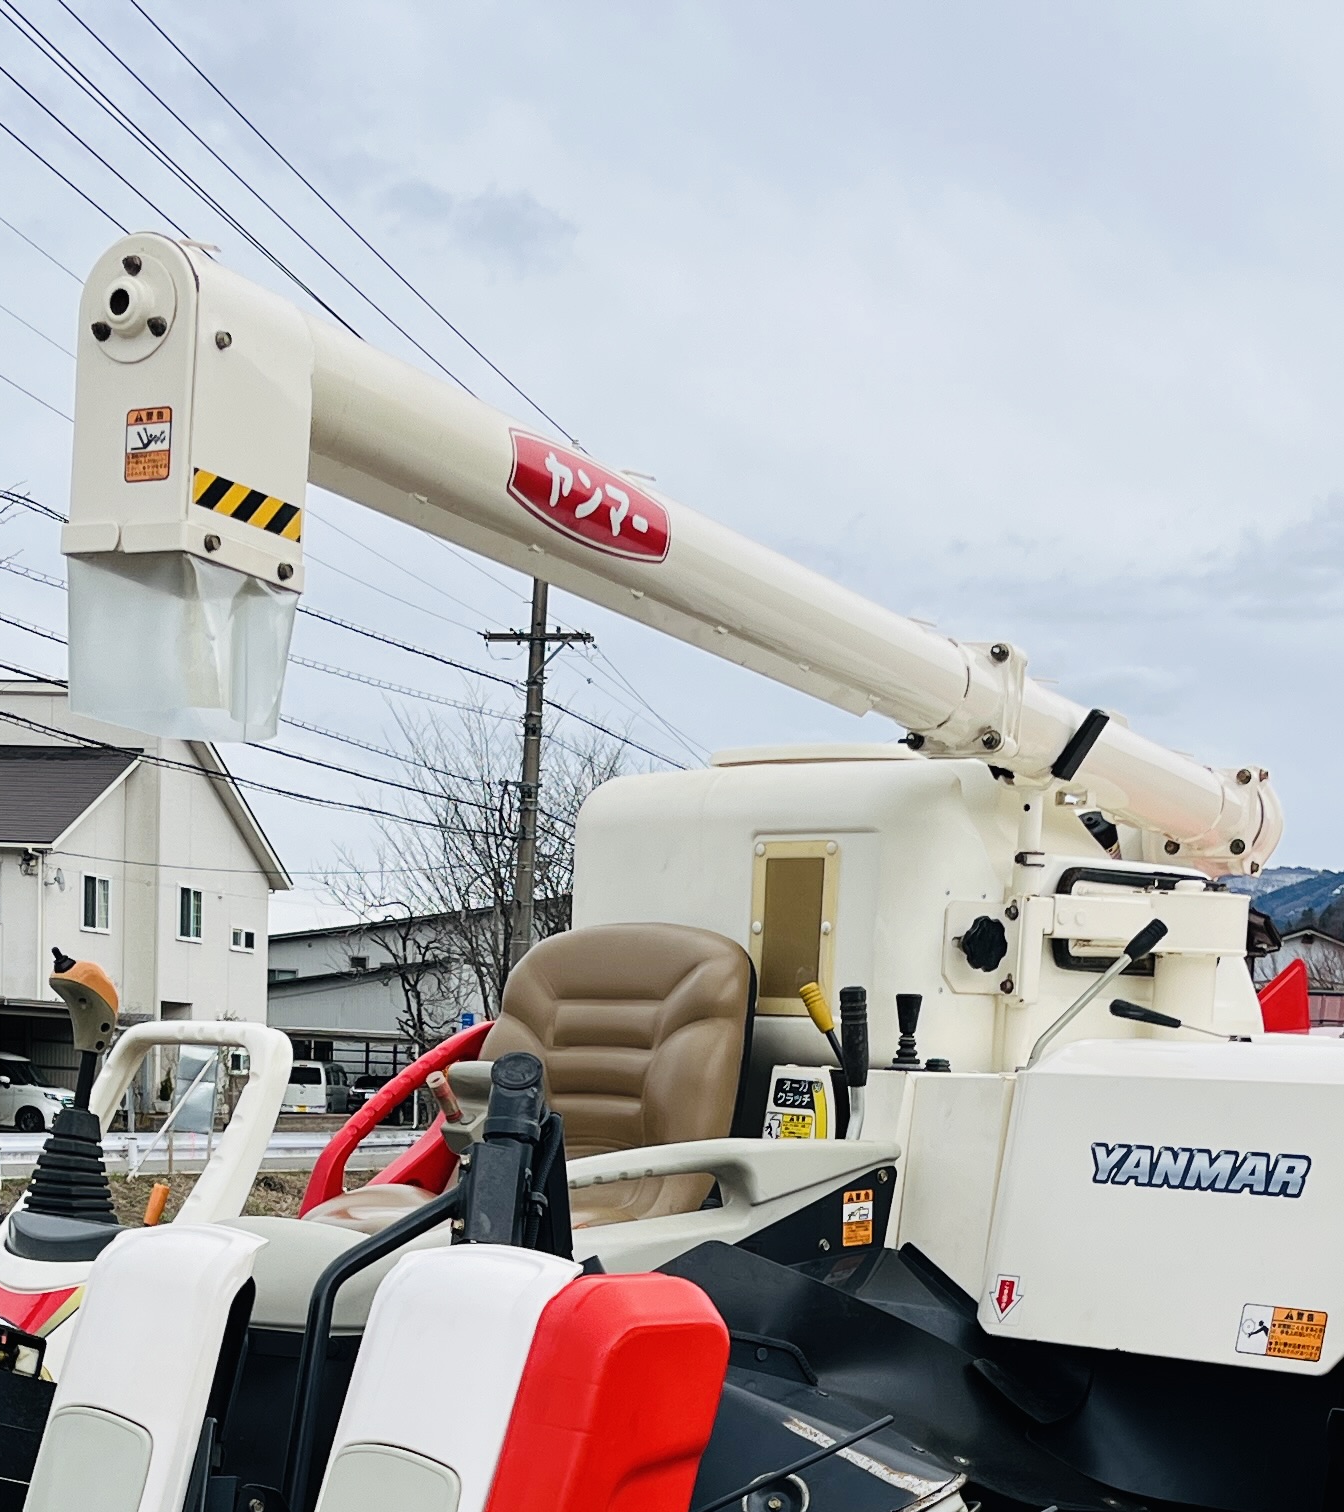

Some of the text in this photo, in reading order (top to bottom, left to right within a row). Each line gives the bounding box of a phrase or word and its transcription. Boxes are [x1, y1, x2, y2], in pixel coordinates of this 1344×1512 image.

[545, 452, 649, 537] ヤンマー
[777, 1092, 811, 1106] クラッチ
[782, 1080, 809, 1092] オーガ
[1091, 1142, 1312, 1198] YANMAR
